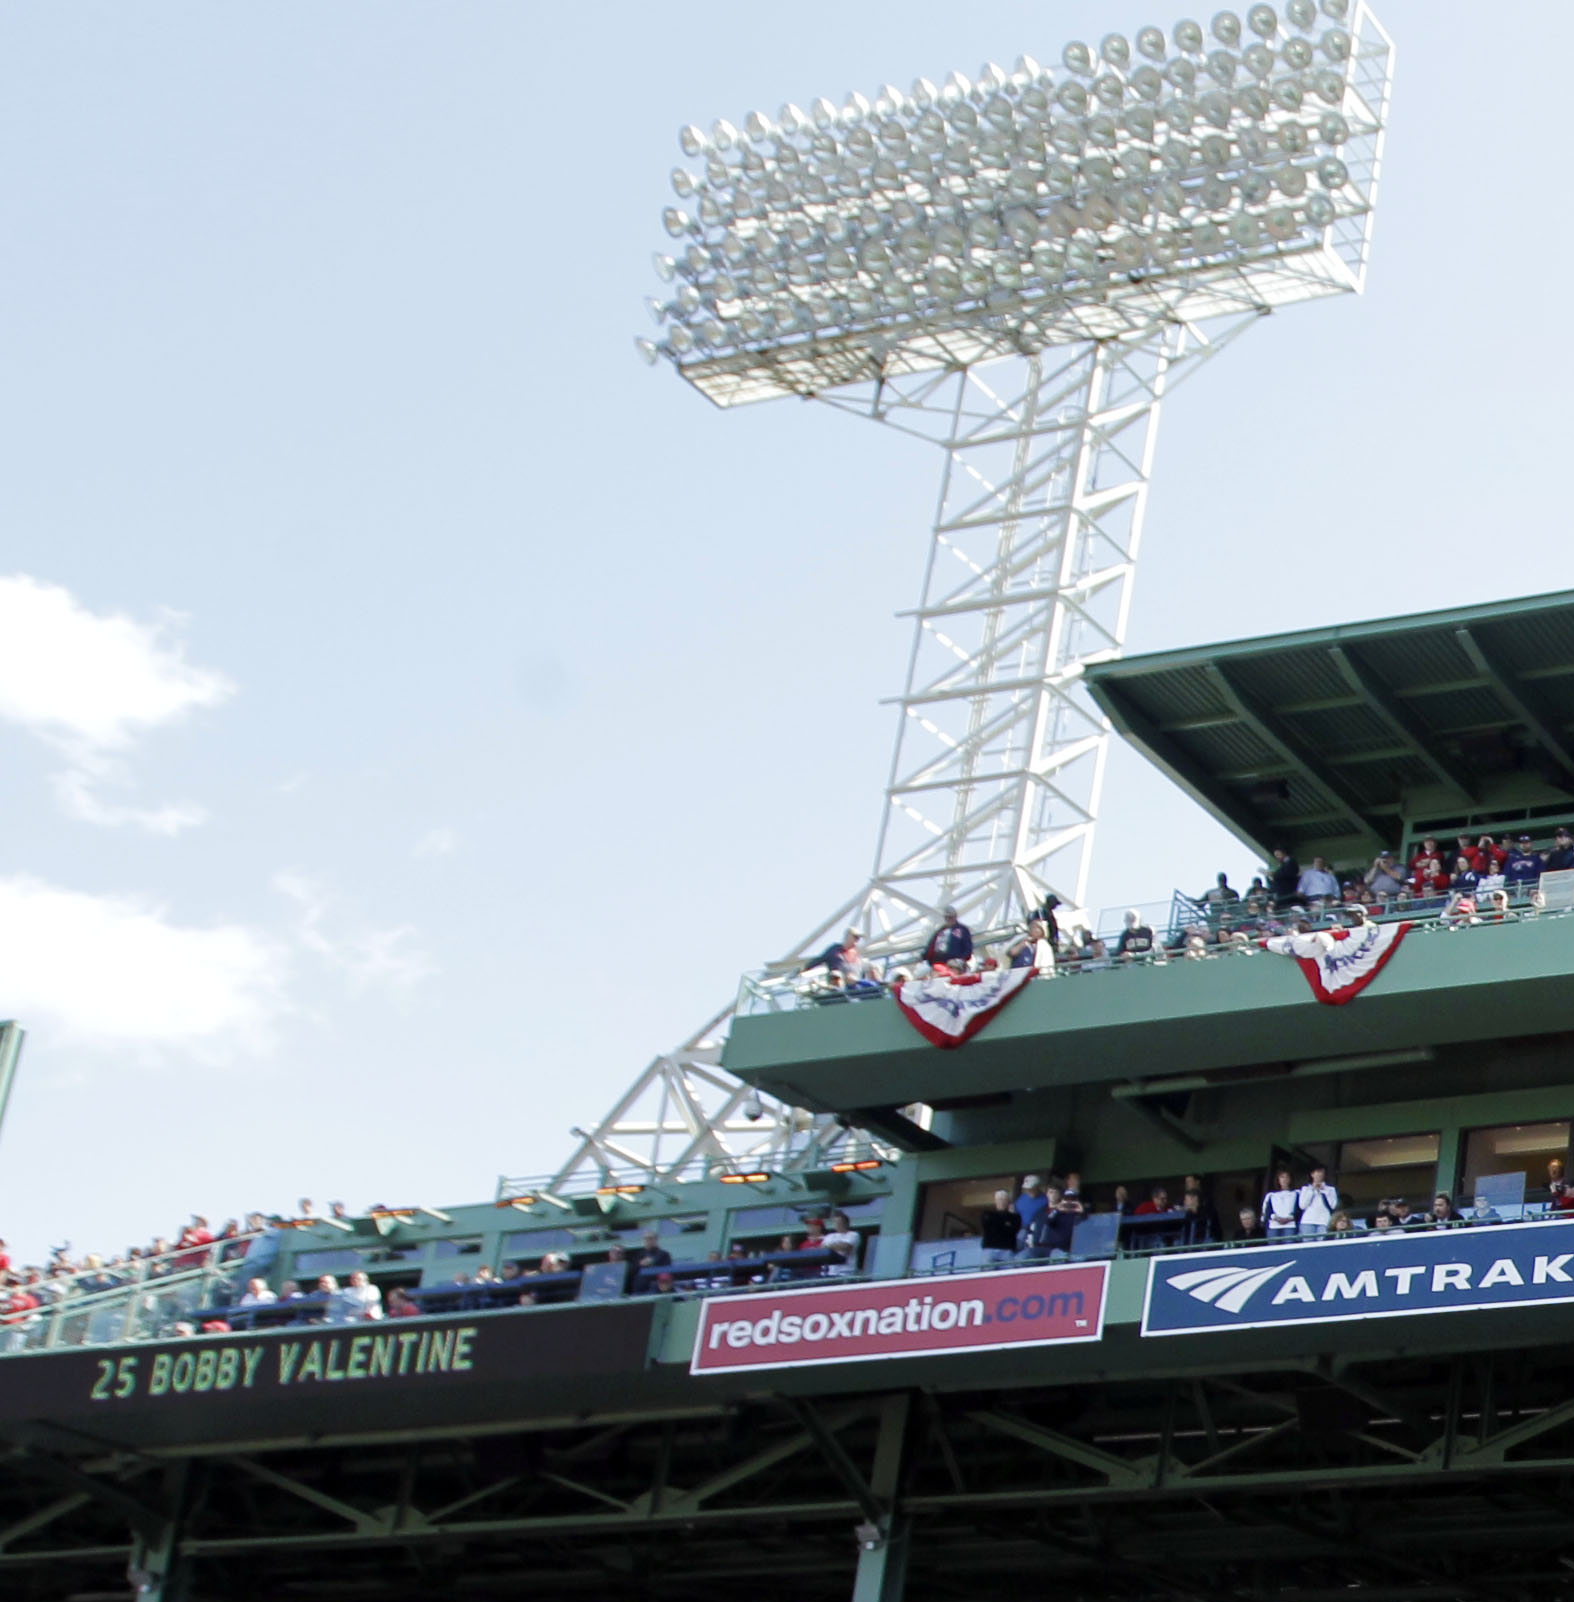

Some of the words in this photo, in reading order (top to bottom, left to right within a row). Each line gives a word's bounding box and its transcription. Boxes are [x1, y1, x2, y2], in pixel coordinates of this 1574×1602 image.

[709, 1290, 1086, 1349] redsoxnation.com
[91, 1356, 139, 1400] 25
[148, 1345, 264, 1395] BOBBY
[278, 1327, 478, 1385] VALENTINE
